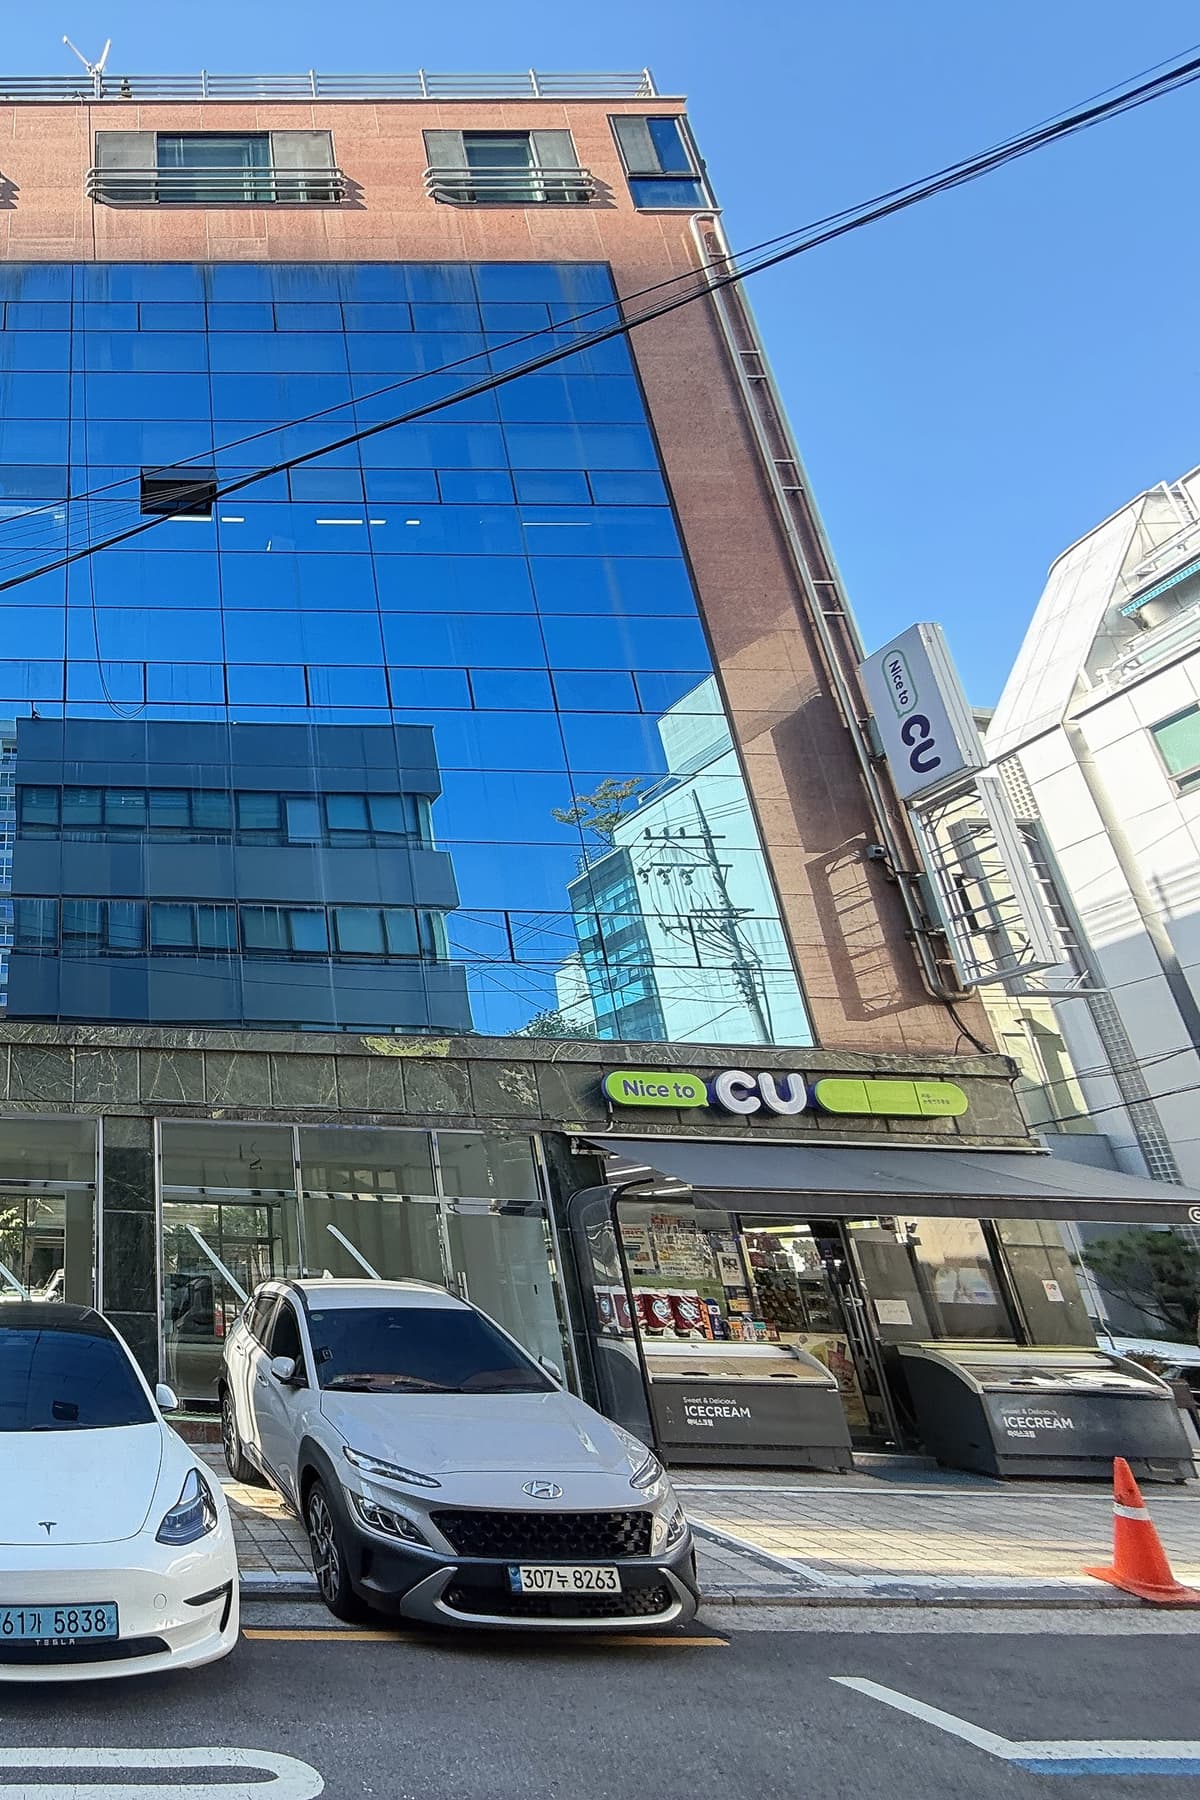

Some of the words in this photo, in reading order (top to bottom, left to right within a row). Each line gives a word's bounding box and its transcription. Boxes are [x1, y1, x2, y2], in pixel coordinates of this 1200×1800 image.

[888, 660, 904, 690] Nice
[898, 689, 909, 705] to
[901, 714, 941, 773] CU
[622, 1079, 669, 1097] Nice
[673, 1082, 695, 1099] to
[715, 1070, 807, 1115] CU
[684, 1405, 752, 1418] ICECREAM
[1003, 1416, 1075, 1429] ICECREAM
[522, 1569, 568, 1589] 307누
[572, 1570, 617, 1589] 8263
[2, 1611, 42, 1635] 61가
[54, 1609, 107, 1634] 5838
[34, 1638, 76, 1646] TESLA
